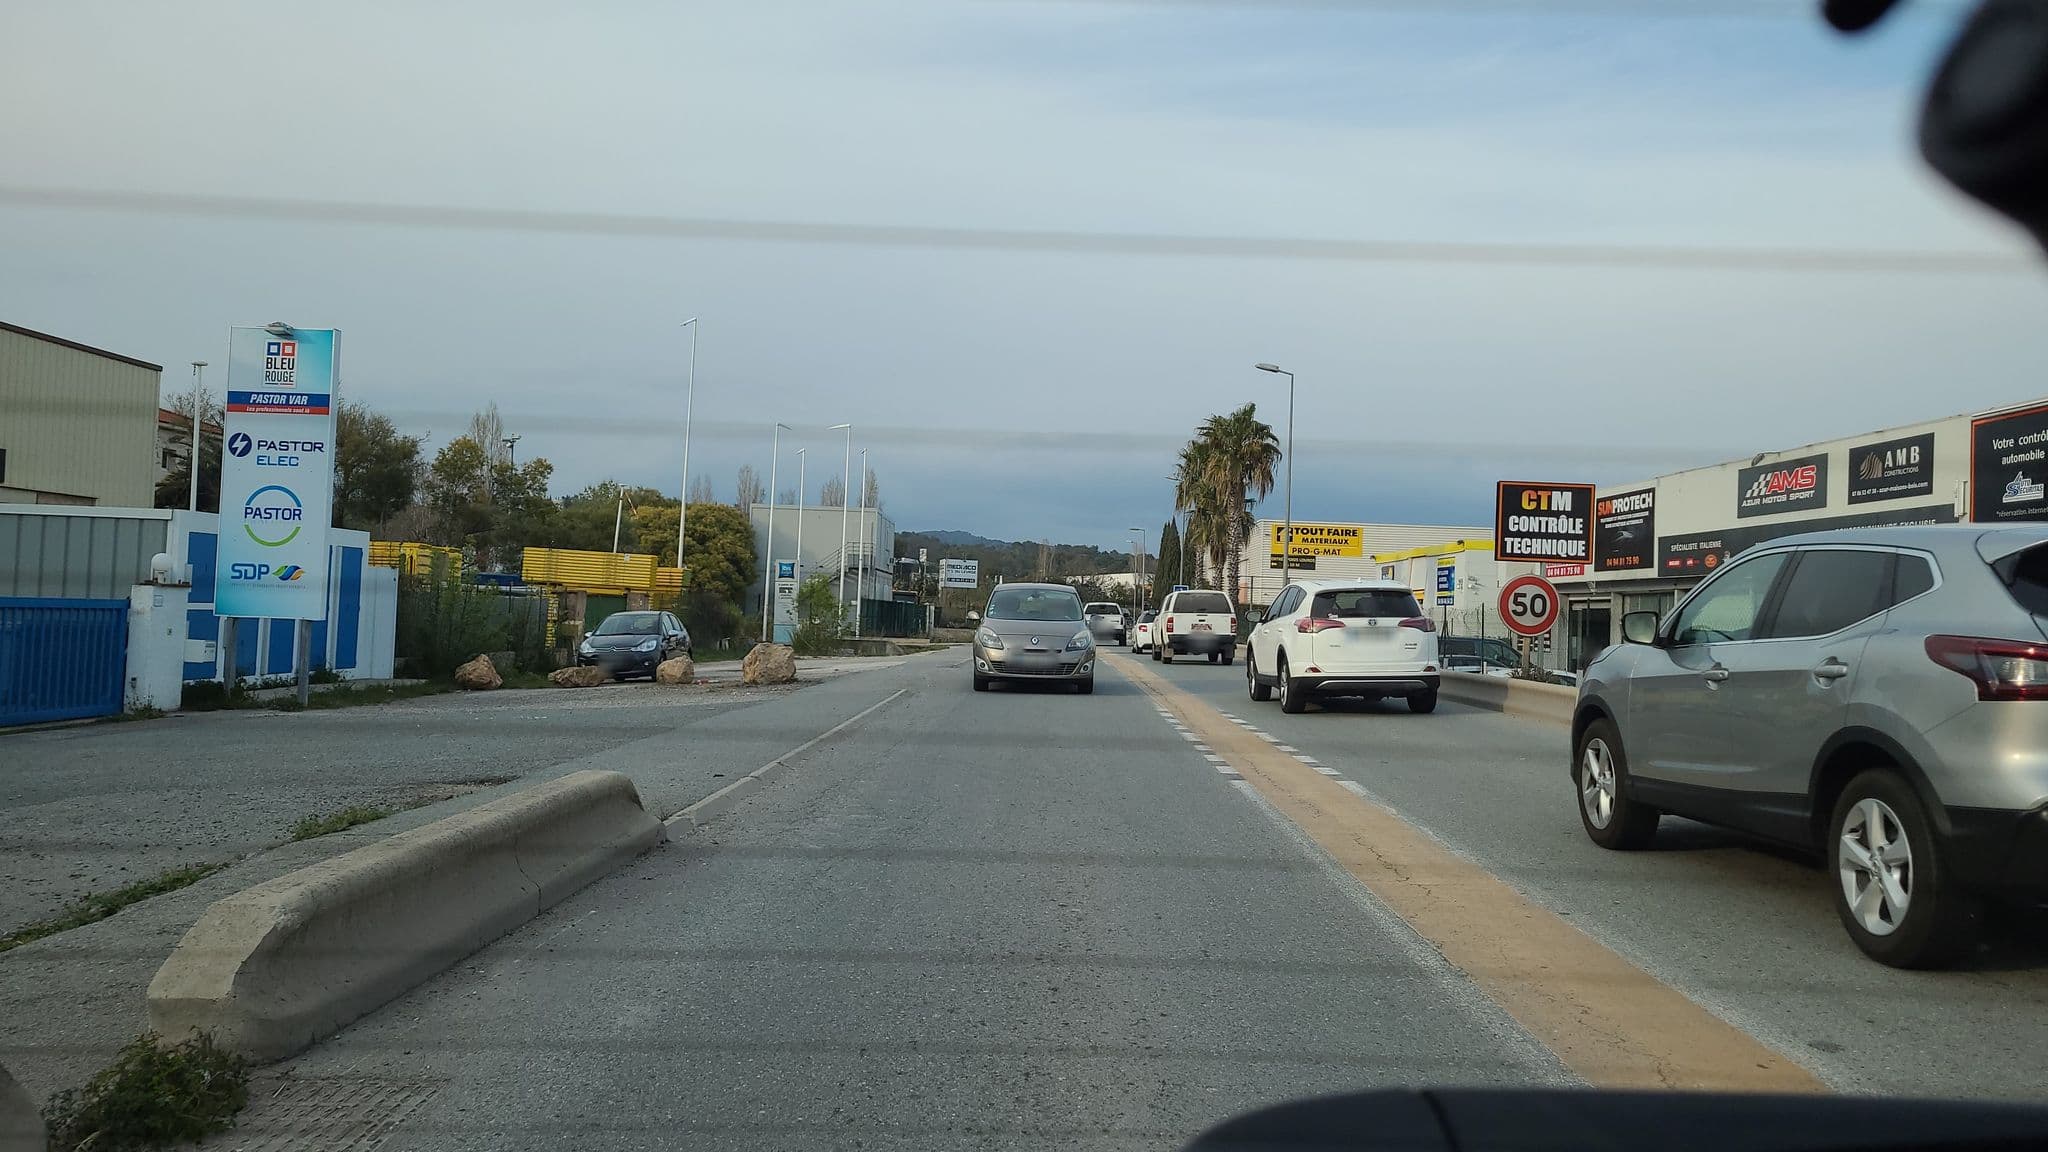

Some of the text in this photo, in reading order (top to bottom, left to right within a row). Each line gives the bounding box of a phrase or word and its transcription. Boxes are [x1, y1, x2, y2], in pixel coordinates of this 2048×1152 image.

[266, 357, 295, 370] BLEU
[265, 371, 294, 382] ROUGE
[249, 394, 309, 405] PASTOR VAR
[257, 440, 325, 452] PASTOR
[1992, 438, 2014, 450] Votre
[256, 455, 299, 466] ELEC
[2001, 449, 2046, 465] automobile
[1766, 465, 1817, 495] AMS
[1521, 490, 1572, 512] CTM
[1741, 490, 1815, 507] AZUR MOTOS SPORT
[244, 507, 302, 520] PASTOR
[1508, 515, 1583, 534] CONTRÔLE
[1294, 527, 1358, 537] TOUT FAIRE
[1301, 537, 1349, 545] MATERIAUX
[1504, 537, 1586, 557] TECHNIQUE
[1670, 540, 1722, 552] SPÉCIALISTE ITALIENNE
[230, 563, 270, 580] SDP
[1511, 592, 1548, 618] 50
